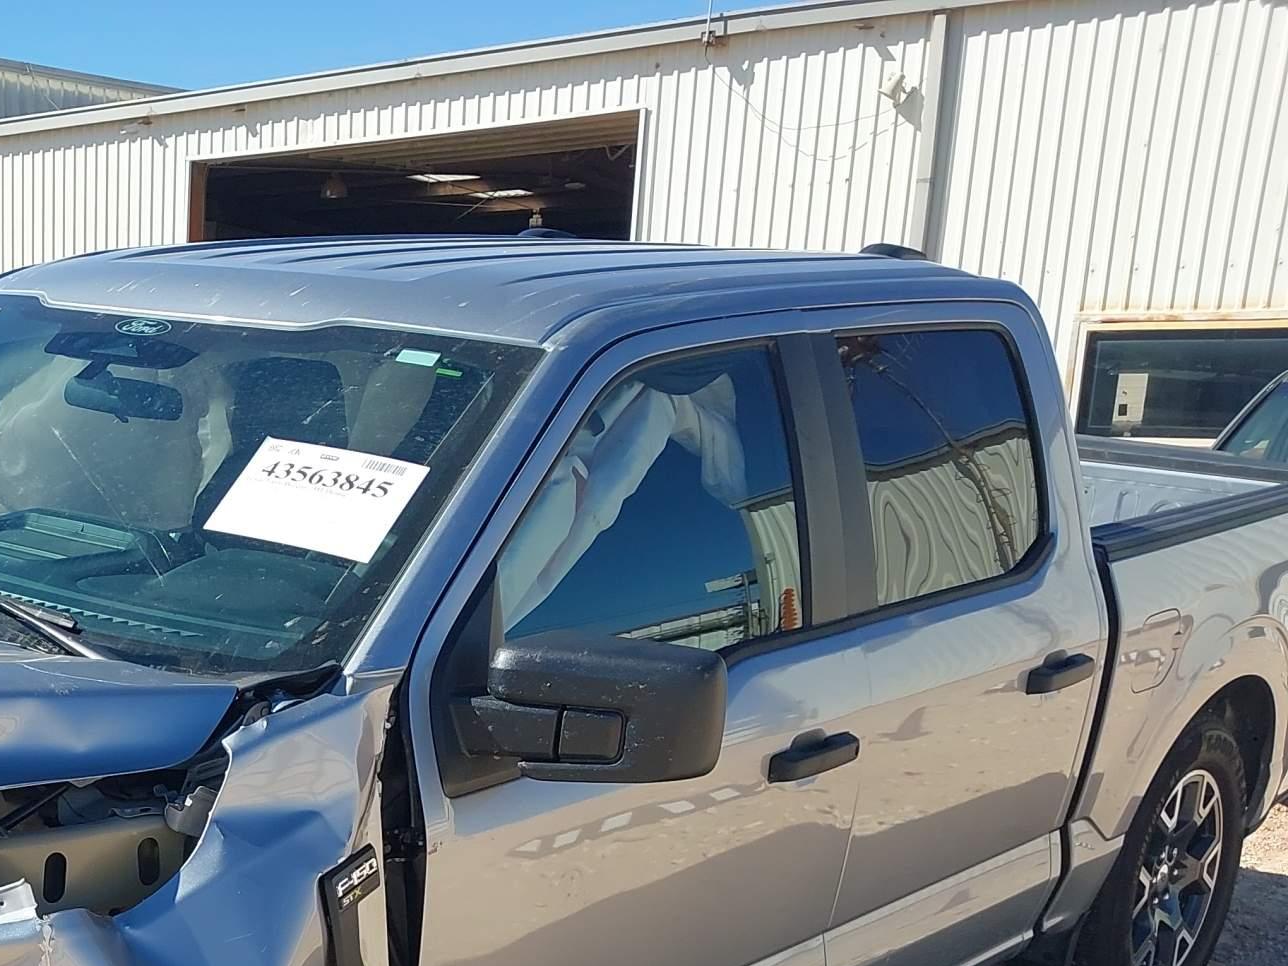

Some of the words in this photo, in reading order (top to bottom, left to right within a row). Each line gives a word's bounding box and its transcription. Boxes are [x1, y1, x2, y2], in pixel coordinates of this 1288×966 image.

[121, 319, 164, 334] Ford
[261, 460, 394, 499] 43563845
[336, 858, 377, 898] F-150
[342, 887, 362, 907] STX
